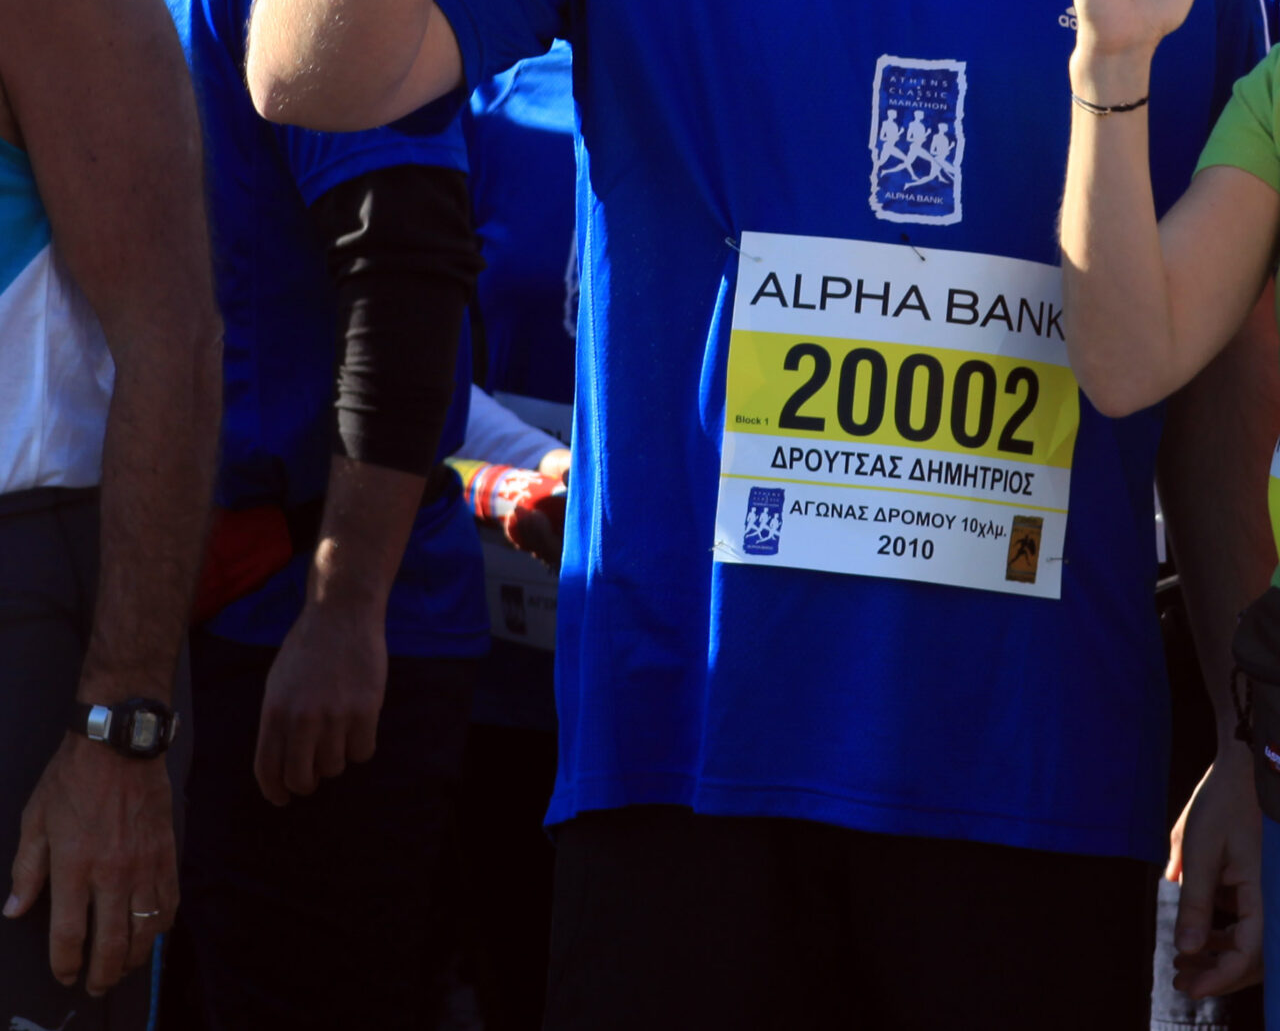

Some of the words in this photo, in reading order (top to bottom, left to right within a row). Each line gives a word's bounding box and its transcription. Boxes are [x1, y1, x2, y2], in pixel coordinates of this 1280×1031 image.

[889, 75, 948, 87] ATHENS
[889, 87, 947, 99] CLASSIC
[888, 98, 947, 111] MARATHON
[884, 191, 916, 202] ALPHA
[917, 194, 944, 205] BANK
[750, 271, 931, 321] ALPHA
[945, 288, 1065, 341] BANK
[778, 343, 1040, 455] 20002
[735, 414, 762, 426] Block
[771, 446, 903, 479] ΔΡΟΥΤΣΑΣ
[908, 458, 1035, 496] ΔΗΜΗΤΡΙΟΣ
[789, 500, 869, 521] ΑΓΩΝΑΣ
[873, 508, 957, 530] ΔΡΟΜΟΥ
[877, 535, 934, 560] 2010
